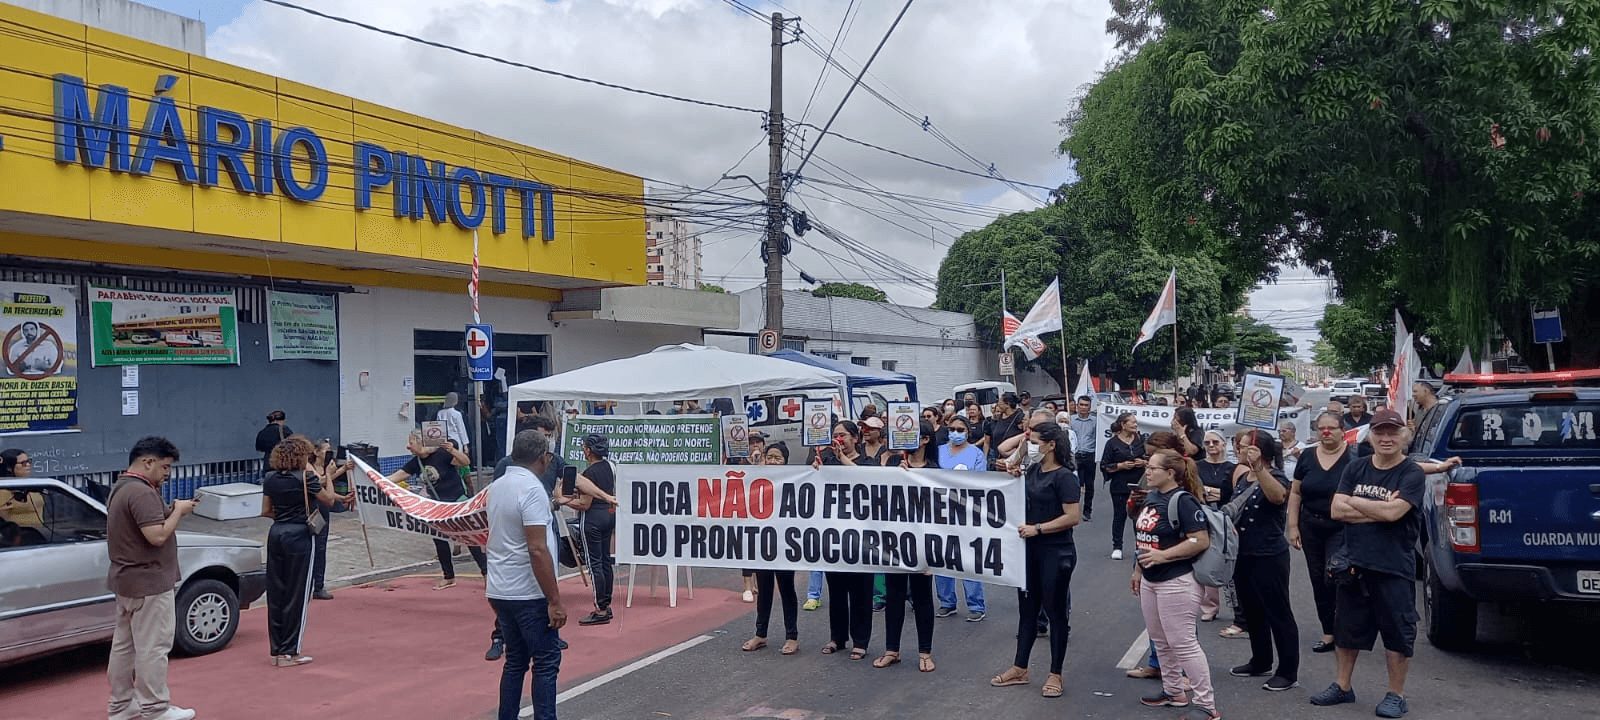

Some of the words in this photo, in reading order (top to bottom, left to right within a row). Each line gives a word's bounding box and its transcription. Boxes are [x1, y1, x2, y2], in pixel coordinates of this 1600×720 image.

[53, 73, 329, 202] MÁRIO
[354, 141, 554, 241] PINOTTI
[4, 306, 12, 314] DA
[1142, 409, 1169, 418] não
[581, 424, 614, 434] PREFEITO
[616, 424, 633, 434] IGOR
[633, 424, 675, 434] NORMANDO
[677, 423, 714, 434] PRETENDE
[634, 438, 670, 448] HOSPITAL
[673, 438, 682, 448] DO
[631, 480, 692, 515] DIGA
[698, 471, 774, 519] NÃO
[779, 482, 817, 519] AO
[823, 482, 1008, 529] FECHAMENTO
[386, 510, 404, 529] DE
[1489, 510, 1512, 524] R-01
[1523, 532, 1574, 546] GUARDA
[633, 523, 667, 558] DO
[674, 523, 778, 562] PRONTO
[785, 526, 919, 568] SOCORRO
[925, 533, 965, 572] DA
[970, 537, 1004, 577] 14
